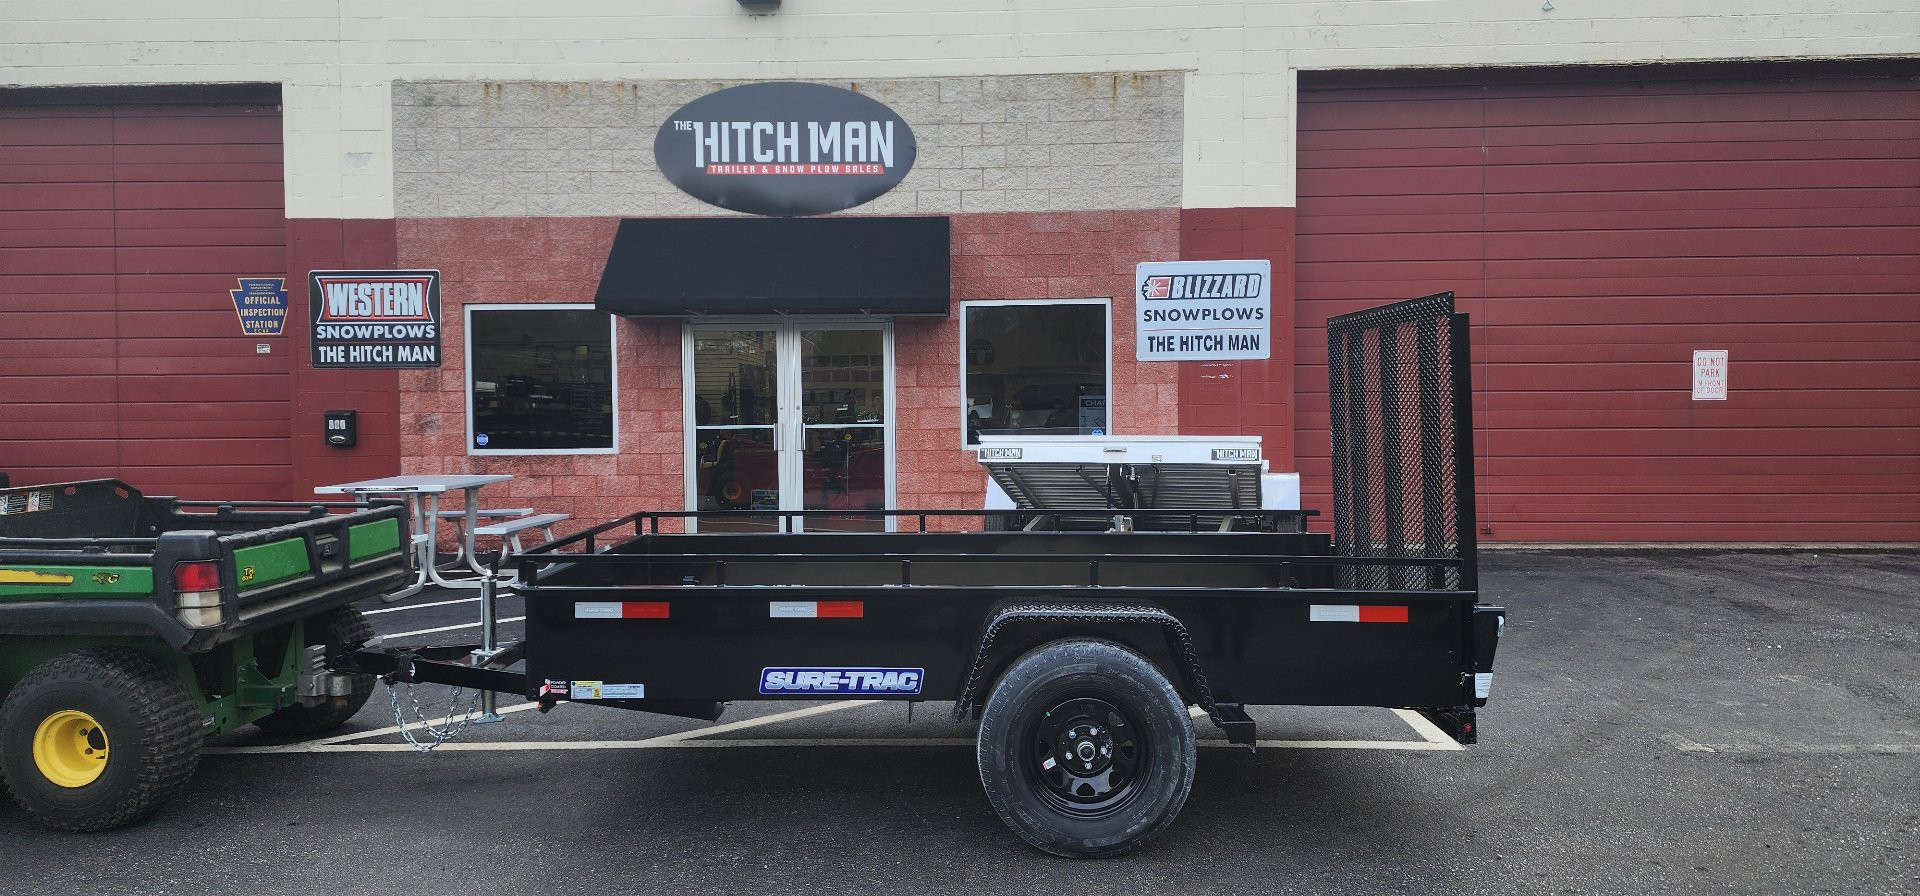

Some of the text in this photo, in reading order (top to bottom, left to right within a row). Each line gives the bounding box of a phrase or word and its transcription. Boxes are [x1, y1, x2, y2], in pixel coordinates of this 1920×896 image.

[674, 120, 894, 167] THE HITCH MAN
[711, 163, 879, 173] TRAILER & SNOW PLOW SALES
[1171, 274, 1260, 298] BLIZZARD
[244, 296, 281, 305] OFFICIAL
[326, 282, 422, 316] WESTERN
[240, 308, 284, 317] INSPECTION
[1143, 307, 1264, 322] SNOWPLOWS
[245, 320, 279, 329] STATION
[316, 325, 435, 339] SNOWPLOWS
[1147, 334, 1260, 352] THE HITCH MAN
[319, 345, 435, 362] THE HITCH MAN
[1697, 357, 1724, 366] DO NOT
[1701, 368, 1720, 377] PARK
[984, 448, 1004, 457] HITCH
[1216, 449, 1258, 459] HITCH MAN
[765, 671, 919, 691] SURE-TRAC
